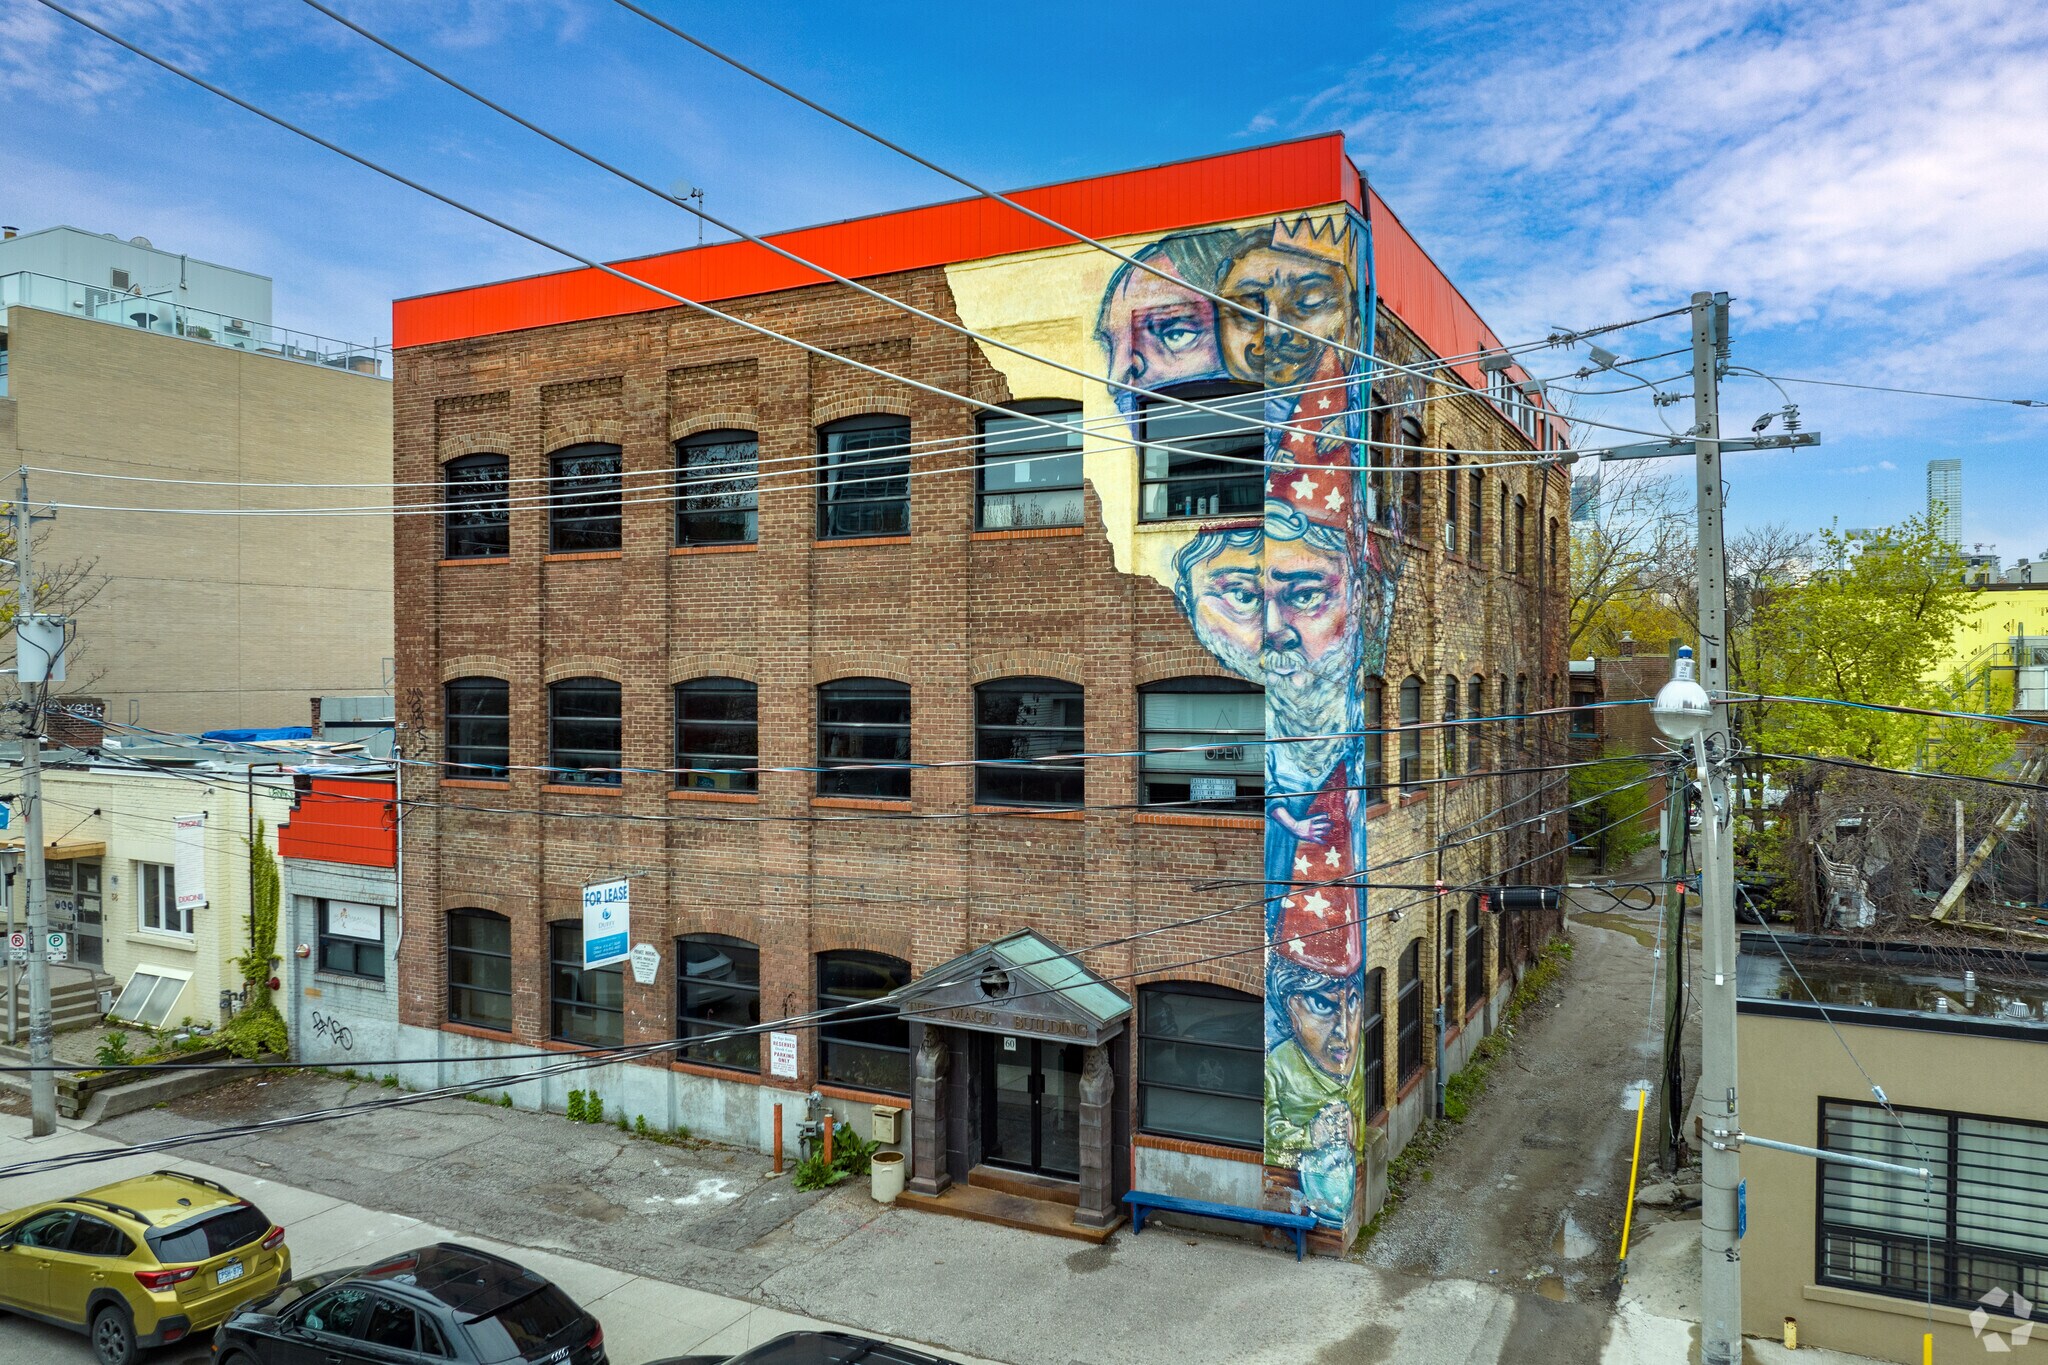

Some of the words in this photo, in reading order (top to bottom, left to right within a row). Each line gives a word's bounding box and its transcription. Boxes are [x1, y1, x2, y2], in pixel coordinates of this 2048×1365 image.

[1205, 746, 1242, 760] OPEN
[585, 890, 602, 907] FOR
[604, 885, 628, 903] LEASE
[907, 1002, 936, 1017] THE
[951, 1008, 998, 1026] MAGIC
[1013, 1015, 1088, 1038] BUILDING
[773, 1041, 796, 1049] RESERVED
[1005, 1039, 1015, 1049] 60
[774, 1051, 795, 1060] PARKING
